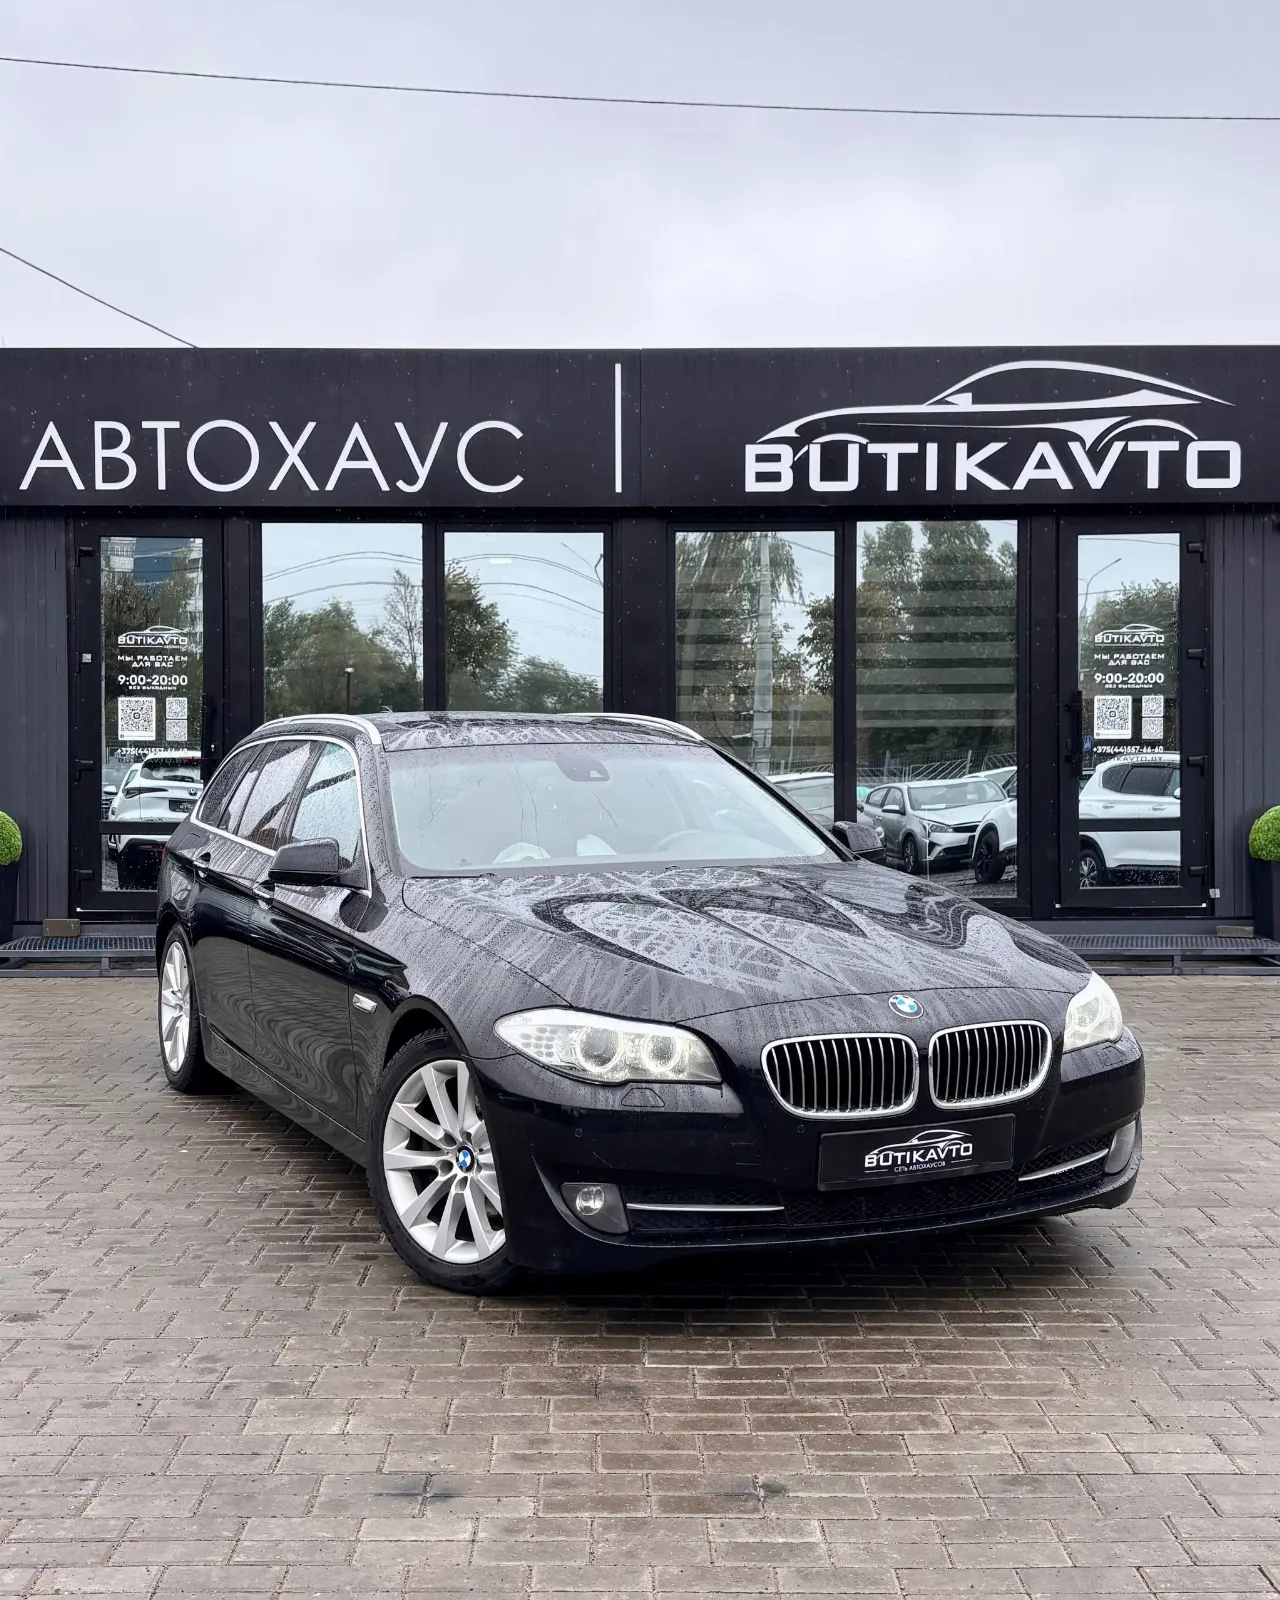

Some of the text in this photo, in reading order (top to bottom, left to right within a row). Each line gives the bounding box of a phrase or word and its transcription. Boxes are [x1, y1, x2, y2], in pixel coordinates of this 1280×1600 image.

[20, 420, 524, 493] АВТОХАУС
[745, 440, 1242, 492] BUTIKAVTO
[117, 636, 188, 645] BUTIKAVTO
[1094, 634, 1165, 643] BUTIKAVTO
[117, 674, 188, 686] 9:00-20:00
[1094, 672, 1165, 684] 9:00-20:00
[864, 1143, 973, 1168] BUTIKAVTO
